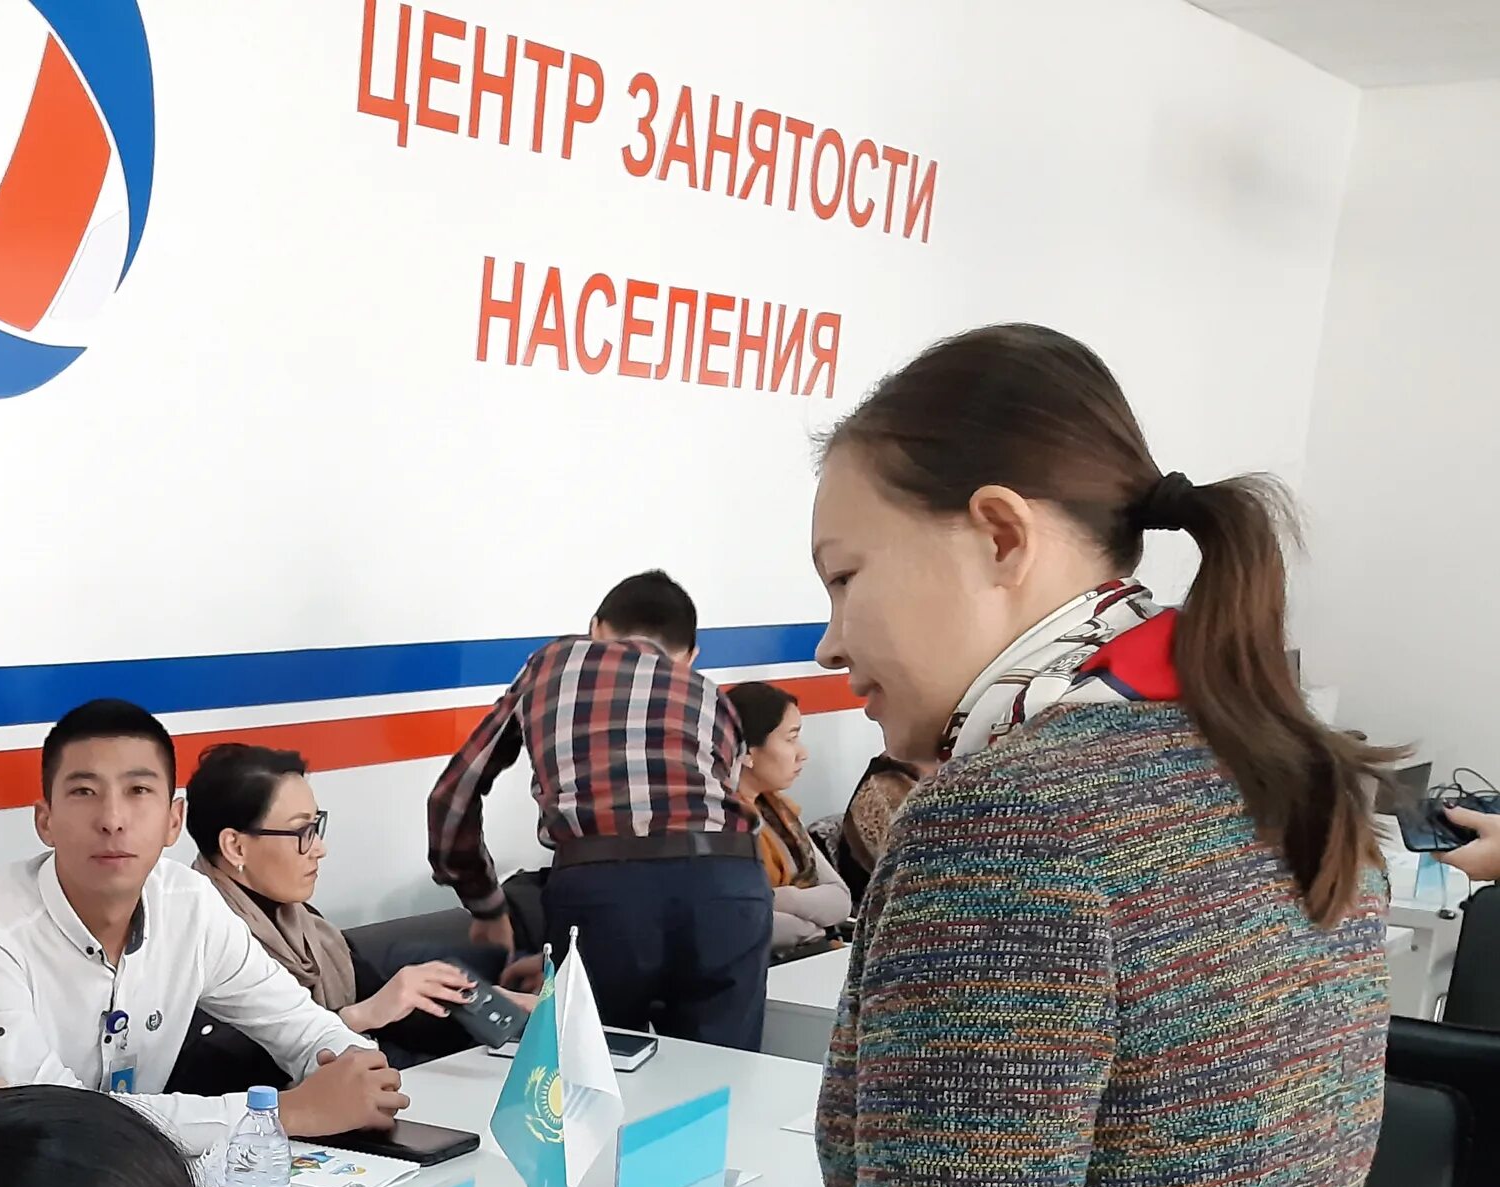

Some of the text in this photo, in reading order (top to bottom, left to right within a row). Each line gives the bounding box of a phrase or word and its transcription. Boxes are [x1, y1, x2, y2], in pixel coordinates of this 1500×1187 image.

[357, 0, 939, 244] ЦЕНТР ЗАНЯТОСТИ
[475, 256, 842, 399] НАСЕЛЕНИЯ
